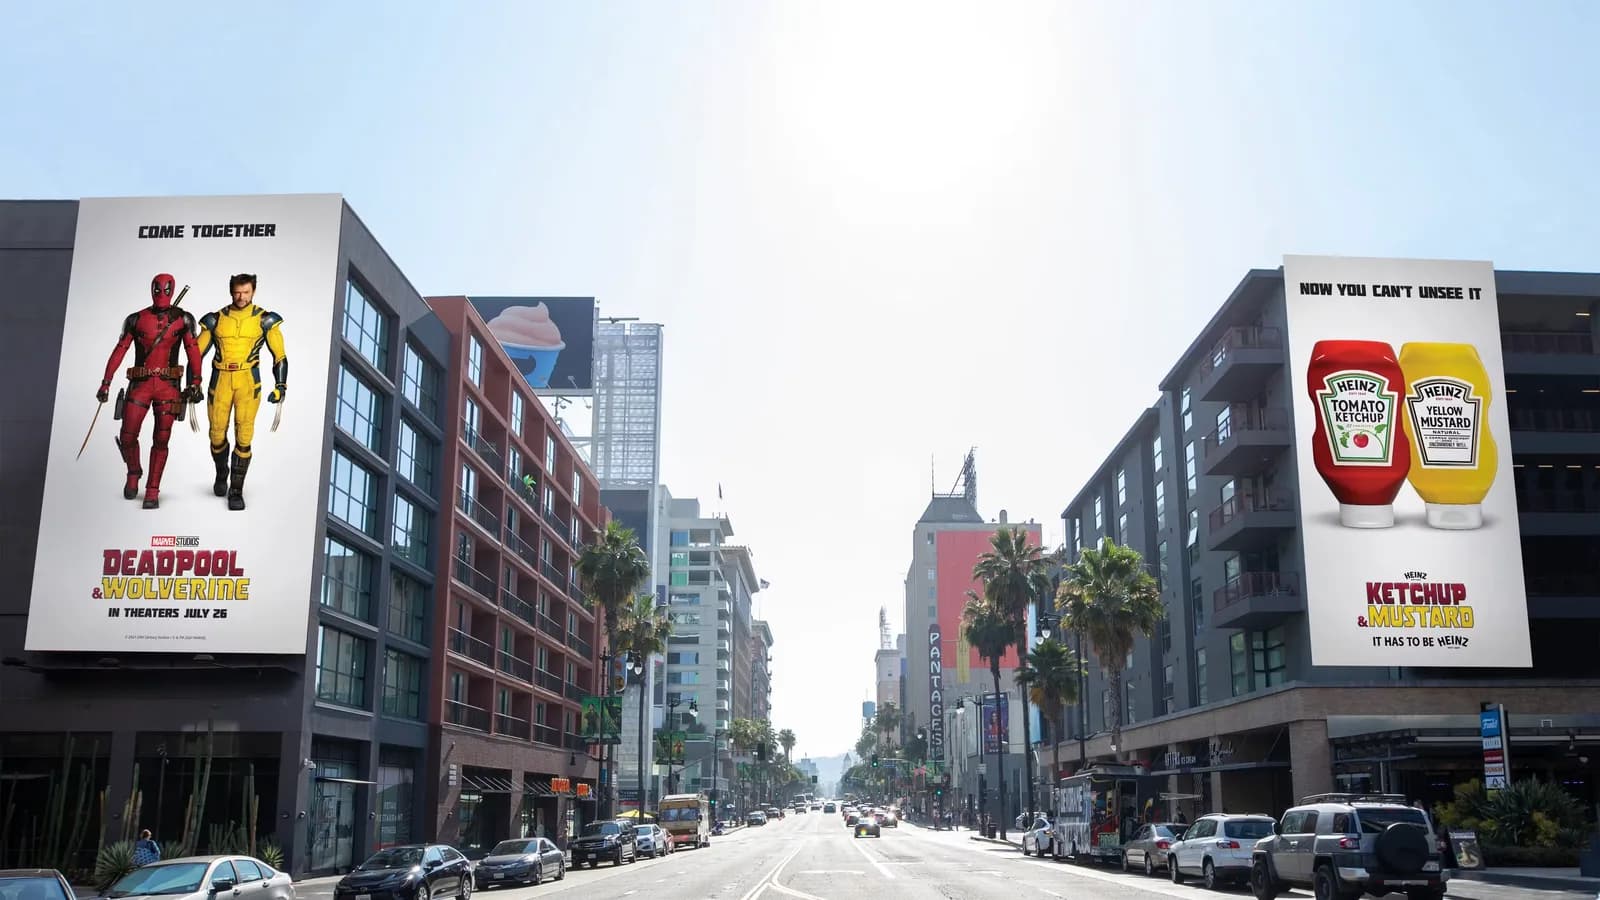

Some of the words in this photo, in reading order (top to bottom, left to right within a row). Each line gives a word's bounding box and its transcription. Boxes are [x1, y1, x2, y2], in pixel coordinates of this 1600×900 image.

[138, 225, 184, 239] COME
[191, 223, 276, 238] TOGETHER
[1300, 282, 1333, 296] NOW
[1337, 283, 1367, 297] YOU
[1372, 285, 1412, 298] CAN'T
[1418, 286, 1464, 300] UNSEE
[1469, 287, 1482, 300] IT
[1336, 379, 1377, 394] HEINZ
[1424, 386, 1462, 399] HEINZ
[1331, 400, 1385, 413] TOMATO
[1426, 406, 1463, 417] YELLOW
[1335, 412, 1384, 423] KETCHUP
[1421, 416, 1471, 428] MUSTARD
[152, 537, 175, 546] MARVEL
[176, 537, 200, 546] STUDIOS
[103, 549, 244, 576] DEADPOOL
[1404, 571, 1427, 580] HEINZ
[102, 577, 250, 600] WOLVERINE
[1366, 582, 1466, 605] KETCHUP
[108, 607, 120, 618] IN
[124, 607, 180, 618] THEATERS
[183, 608, 210, 619] JULY
[213, 609, 228, 619] 26
[1368, 605, 1474, 628] MUSTARD
[1373, 637, 1381, 647] IT
[1384, 637, 1404, 647] HAS
[1407, 637, 1420, 647] TO
[1423, 637, 1434, 647] BE
[1437, 635, 1469, 647] HEINZ
[929, 632, 943, 746] PANTAGES
